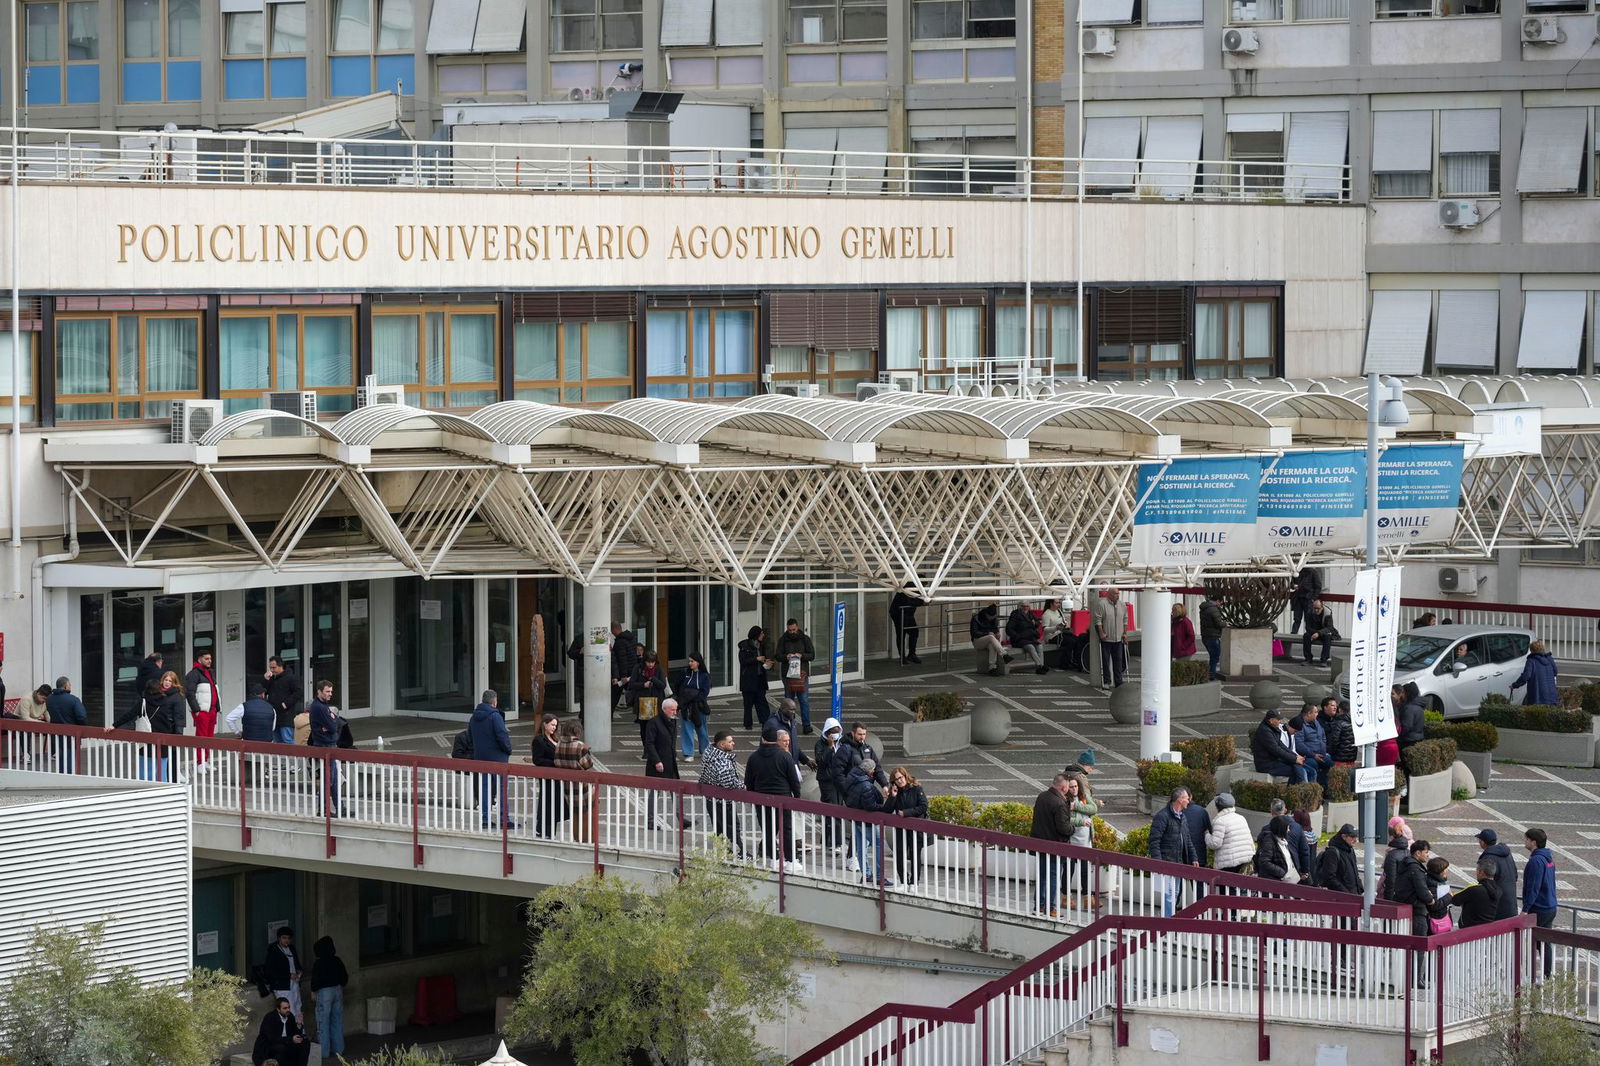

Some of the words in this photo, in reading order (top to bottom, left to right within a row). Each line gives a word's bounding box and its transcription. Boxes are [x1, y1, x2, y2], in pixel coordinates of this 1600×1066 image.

[117, 224, 369, 263] POLICLINICO
[394, 225, 650, 261] UNIVERSITARIO
[667, 225, 822, 260] AGOSTINO
[841, 226, 956, 259] GEMELLI
[1280, 467, 1318, 475] FERMARE
[1320, 467, 1331, 475] LA
[1332, 466, 1358, 475] CURA,
[1315, 475, 1352, 484] RICERCA.
[1159, 482, 1193, 490] SOSTIENI
[1164, 548, 1201, 557] Gemelli
[1378, 635, 1387, 722] Gemelli
[1355, 639, 1365, 728] Gemelli
